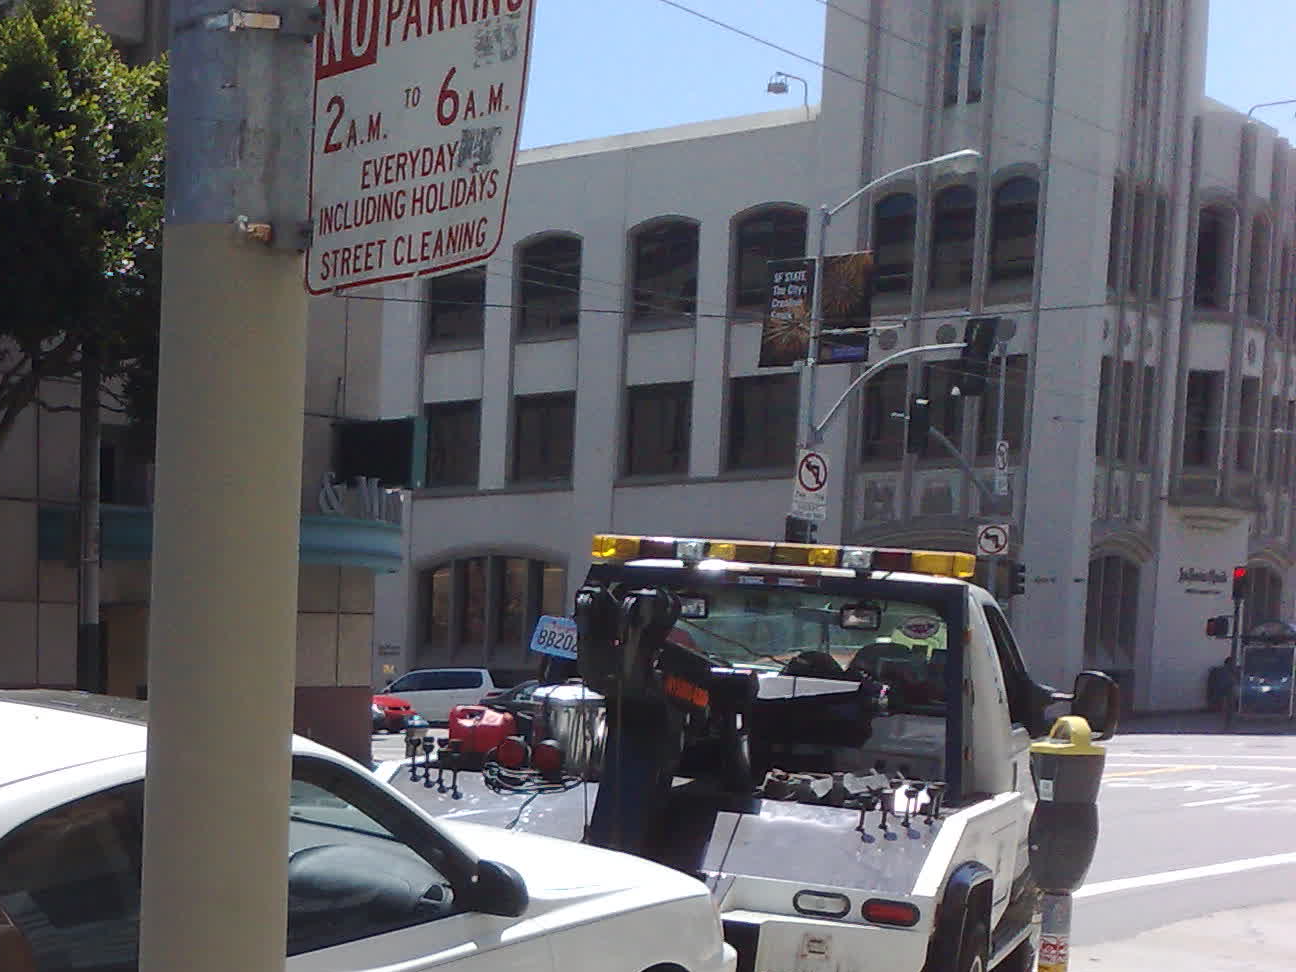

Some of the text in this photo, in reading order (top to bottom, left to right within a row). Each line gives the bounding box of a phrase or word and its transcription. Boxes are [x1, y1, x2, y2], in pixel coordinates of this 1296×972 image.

[321, 0, 373, 66] NO
[384, 0, 523, 47] PARK
[323, 67, 511, 153] 2 A.M. TO 6 A.M.
[360, 141, 460, 190] EVERYDAY
[318, 169, 500, 236] INCLUDING HOLIDAYS
[320, 217, 488, 281] STREET CLEANING
